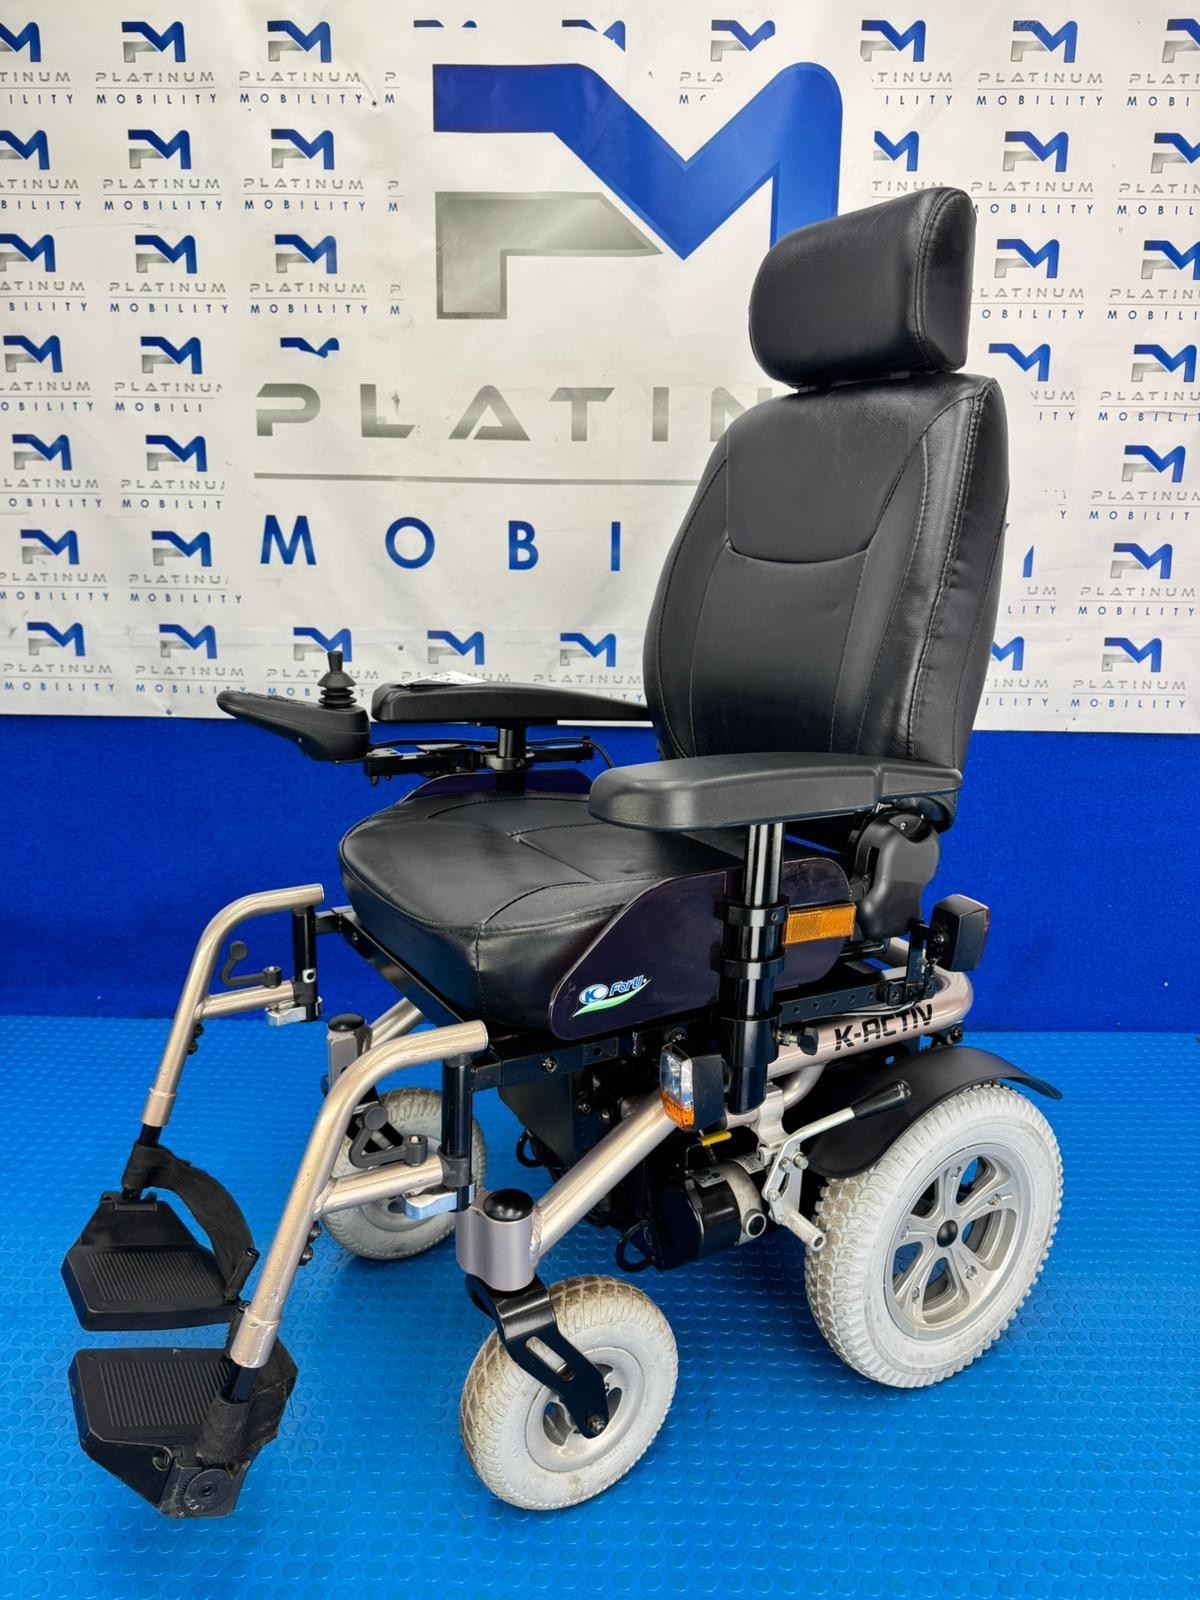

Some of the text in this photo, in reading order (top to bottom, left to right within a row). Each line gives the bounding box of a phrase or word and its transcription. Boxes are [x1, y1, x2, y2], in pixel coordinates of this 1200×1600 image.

[0, 72, 70, 82] TINUM
[96, 72, 214, 82] PLATINUM
[239, 71, 360, 82] PLATINUM
[872, 72, 952, 82] TINUM
[979, 72, 1102, 83] PLATINUM
[1130, 73, 1200, 84] PLATI
[10, 94, 72, 104] ILITY
[97, 94, 216, 104] MOBILITY
[240, 94, 361, 104] MOBILITY
[977, 95, 1102, 105] MOBILITY
[1127, 96, 1189, 106] MOBI
[0, 179, 78, 189] TINUM
[103, 179, 219, 189] PLATINUM
[244, 178, 363, 189] PLATINUM
[971, 182, 1093, 192] PLATINUM
[1119, 183, 1200, 193] PLATIN
[1, 200, 81, 210] BILITY
[105, 200, 222, 210] MOBILITY
[245, 200, 365, 210] MOBILITY
[1117, 205, 1193, 215] MOBIL
[0, 281, 84, 291] ATINUM
[110, 282, 225, 292] PLATINUM
[250, 283, 365, 293] PLATINUM
[979, 288, 1084, 298] LATINUM
[1110, 289, 1200, 299] PLATIN
[9, 301, 86, 311] BILITY
[110, 303, 227, 313] MOBILITY
[251, 303, 367, 313] MOBILITY
[982, 309, 1083, 319] OBILITY
[1108, 310, 1197, 320] MOBILI
[0, 381, 90, 391] ATINUM
[1100, 391, 1200, 401] PLATINU
[1, 401, 93, 411] OBILITY
[115, 402, 201, 412] MOBILI
[256, 383, 772, 441] PLATIN
[4, 478, 99, 488] LATINUM
[9, 497, 101, 507] OBILITY
[1089, 510, 1189, 520] MOBILIT
[260, 515, 622, 572] MOBI
[129, 574, 227, 585] PLATINU
[1080, 587, 1195, 597] PLATINUM
[130, 593, 241, 603] MOBILITY
[1078, 606, 1194, 616] MOBILITY
[4, 663, 112, 674] PLATINUM
[136, 665, 244, 676] PLATINUM
[267, 669, 379, 680] PLATUM
[533, 674, 642, 684] PLATINUM
[5, 681, 114, 691] MOBILITY
[1073, 680, 1185, 690] PLATINUM
[1071, 698, 1184, 708] MOBILITY
[835, 1004, 933, 1050] K-ACTIV
